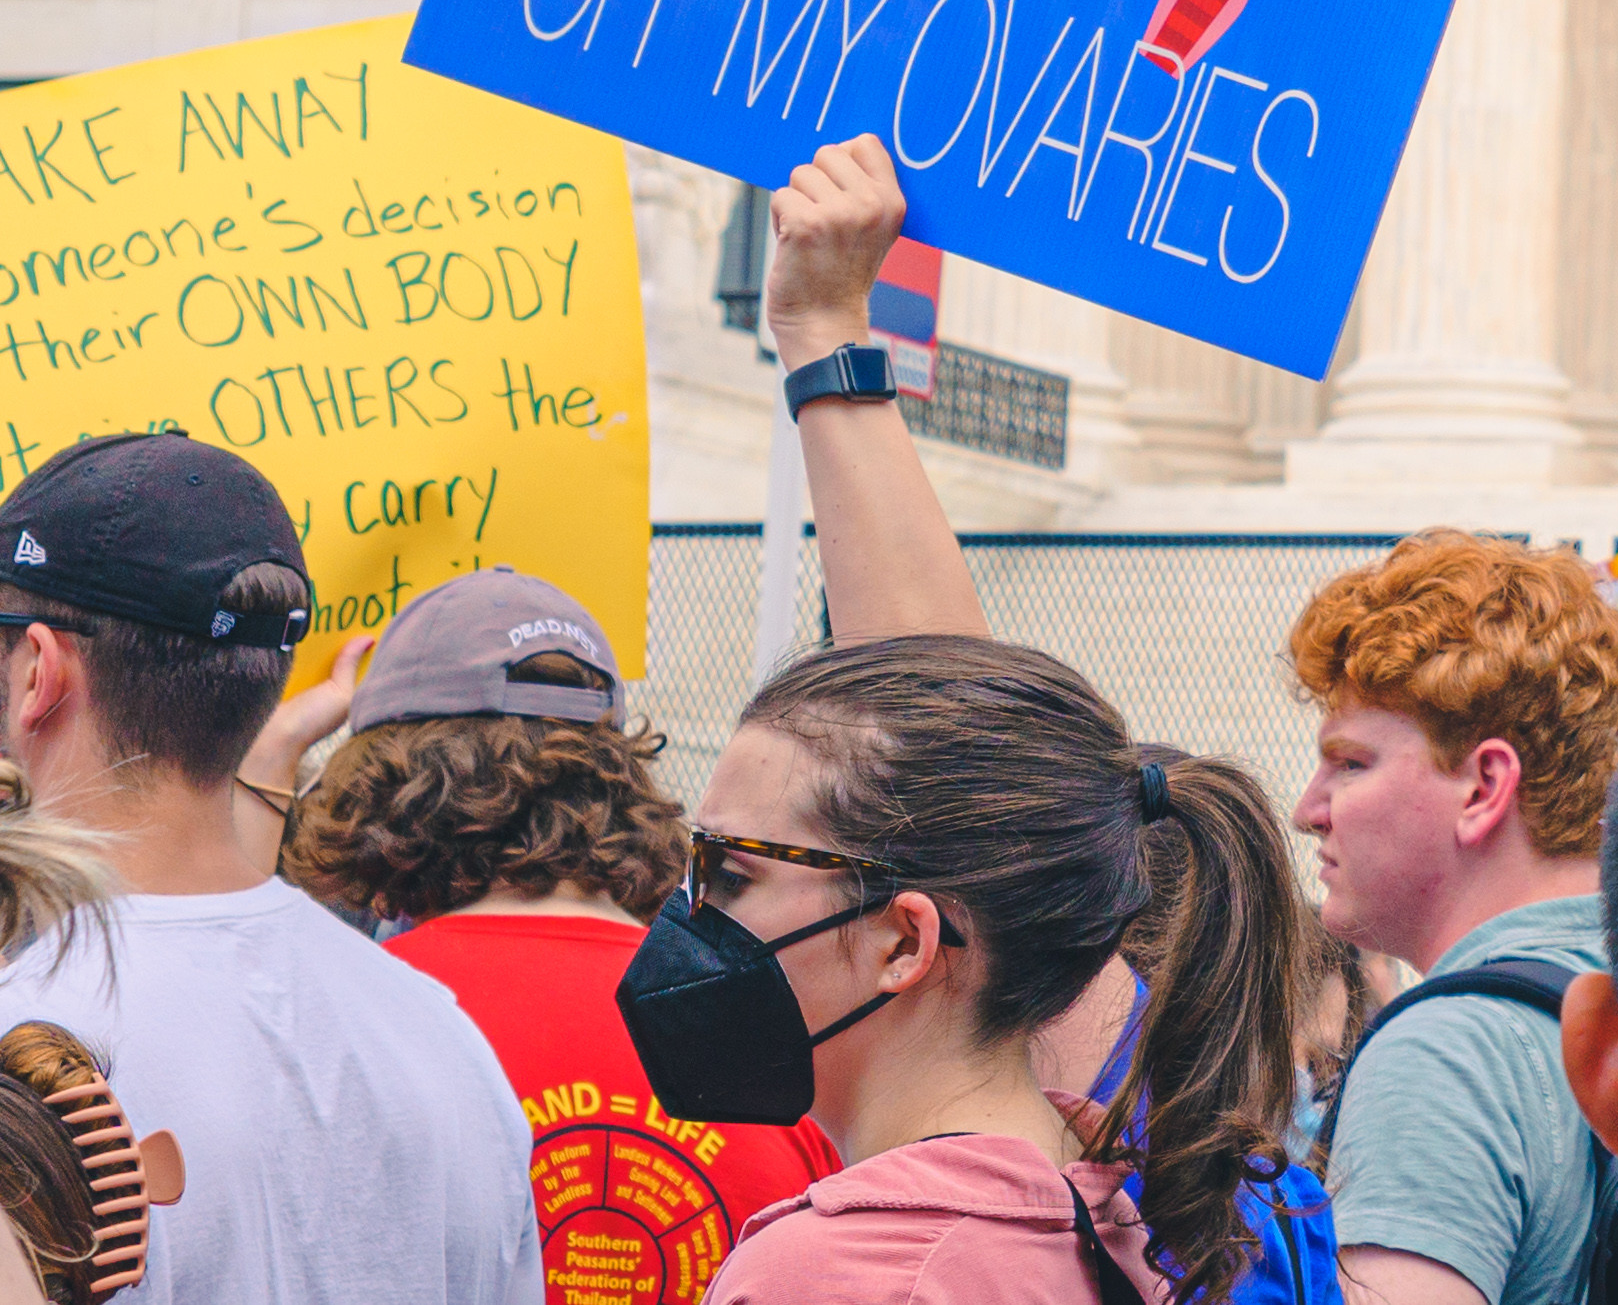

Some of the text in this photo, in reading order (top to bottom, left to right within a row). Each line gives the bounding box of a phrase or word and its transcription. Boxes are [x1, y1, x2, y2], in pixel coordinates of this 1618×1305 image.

[177, 62, 368, 174] AWAY
[342, 169, 583, 238] decision
[0, 239, 580, 381] their OWN BODY
[209, 355, 603, 447] OTHERS the
[343, 466, 498, 543] carry
[549, 1143, 592, 1167] Reform
[542, 1165, 580, 1192] by the
[543, 1182, 593, 1214] Landless
[566, 1230, 642, 1253] Southern
[565, 1250, 641, 1272] Peasants'
[547, 1268, 656, 1293] Federation of
[564, 1289, 633, 1305] Thailand
